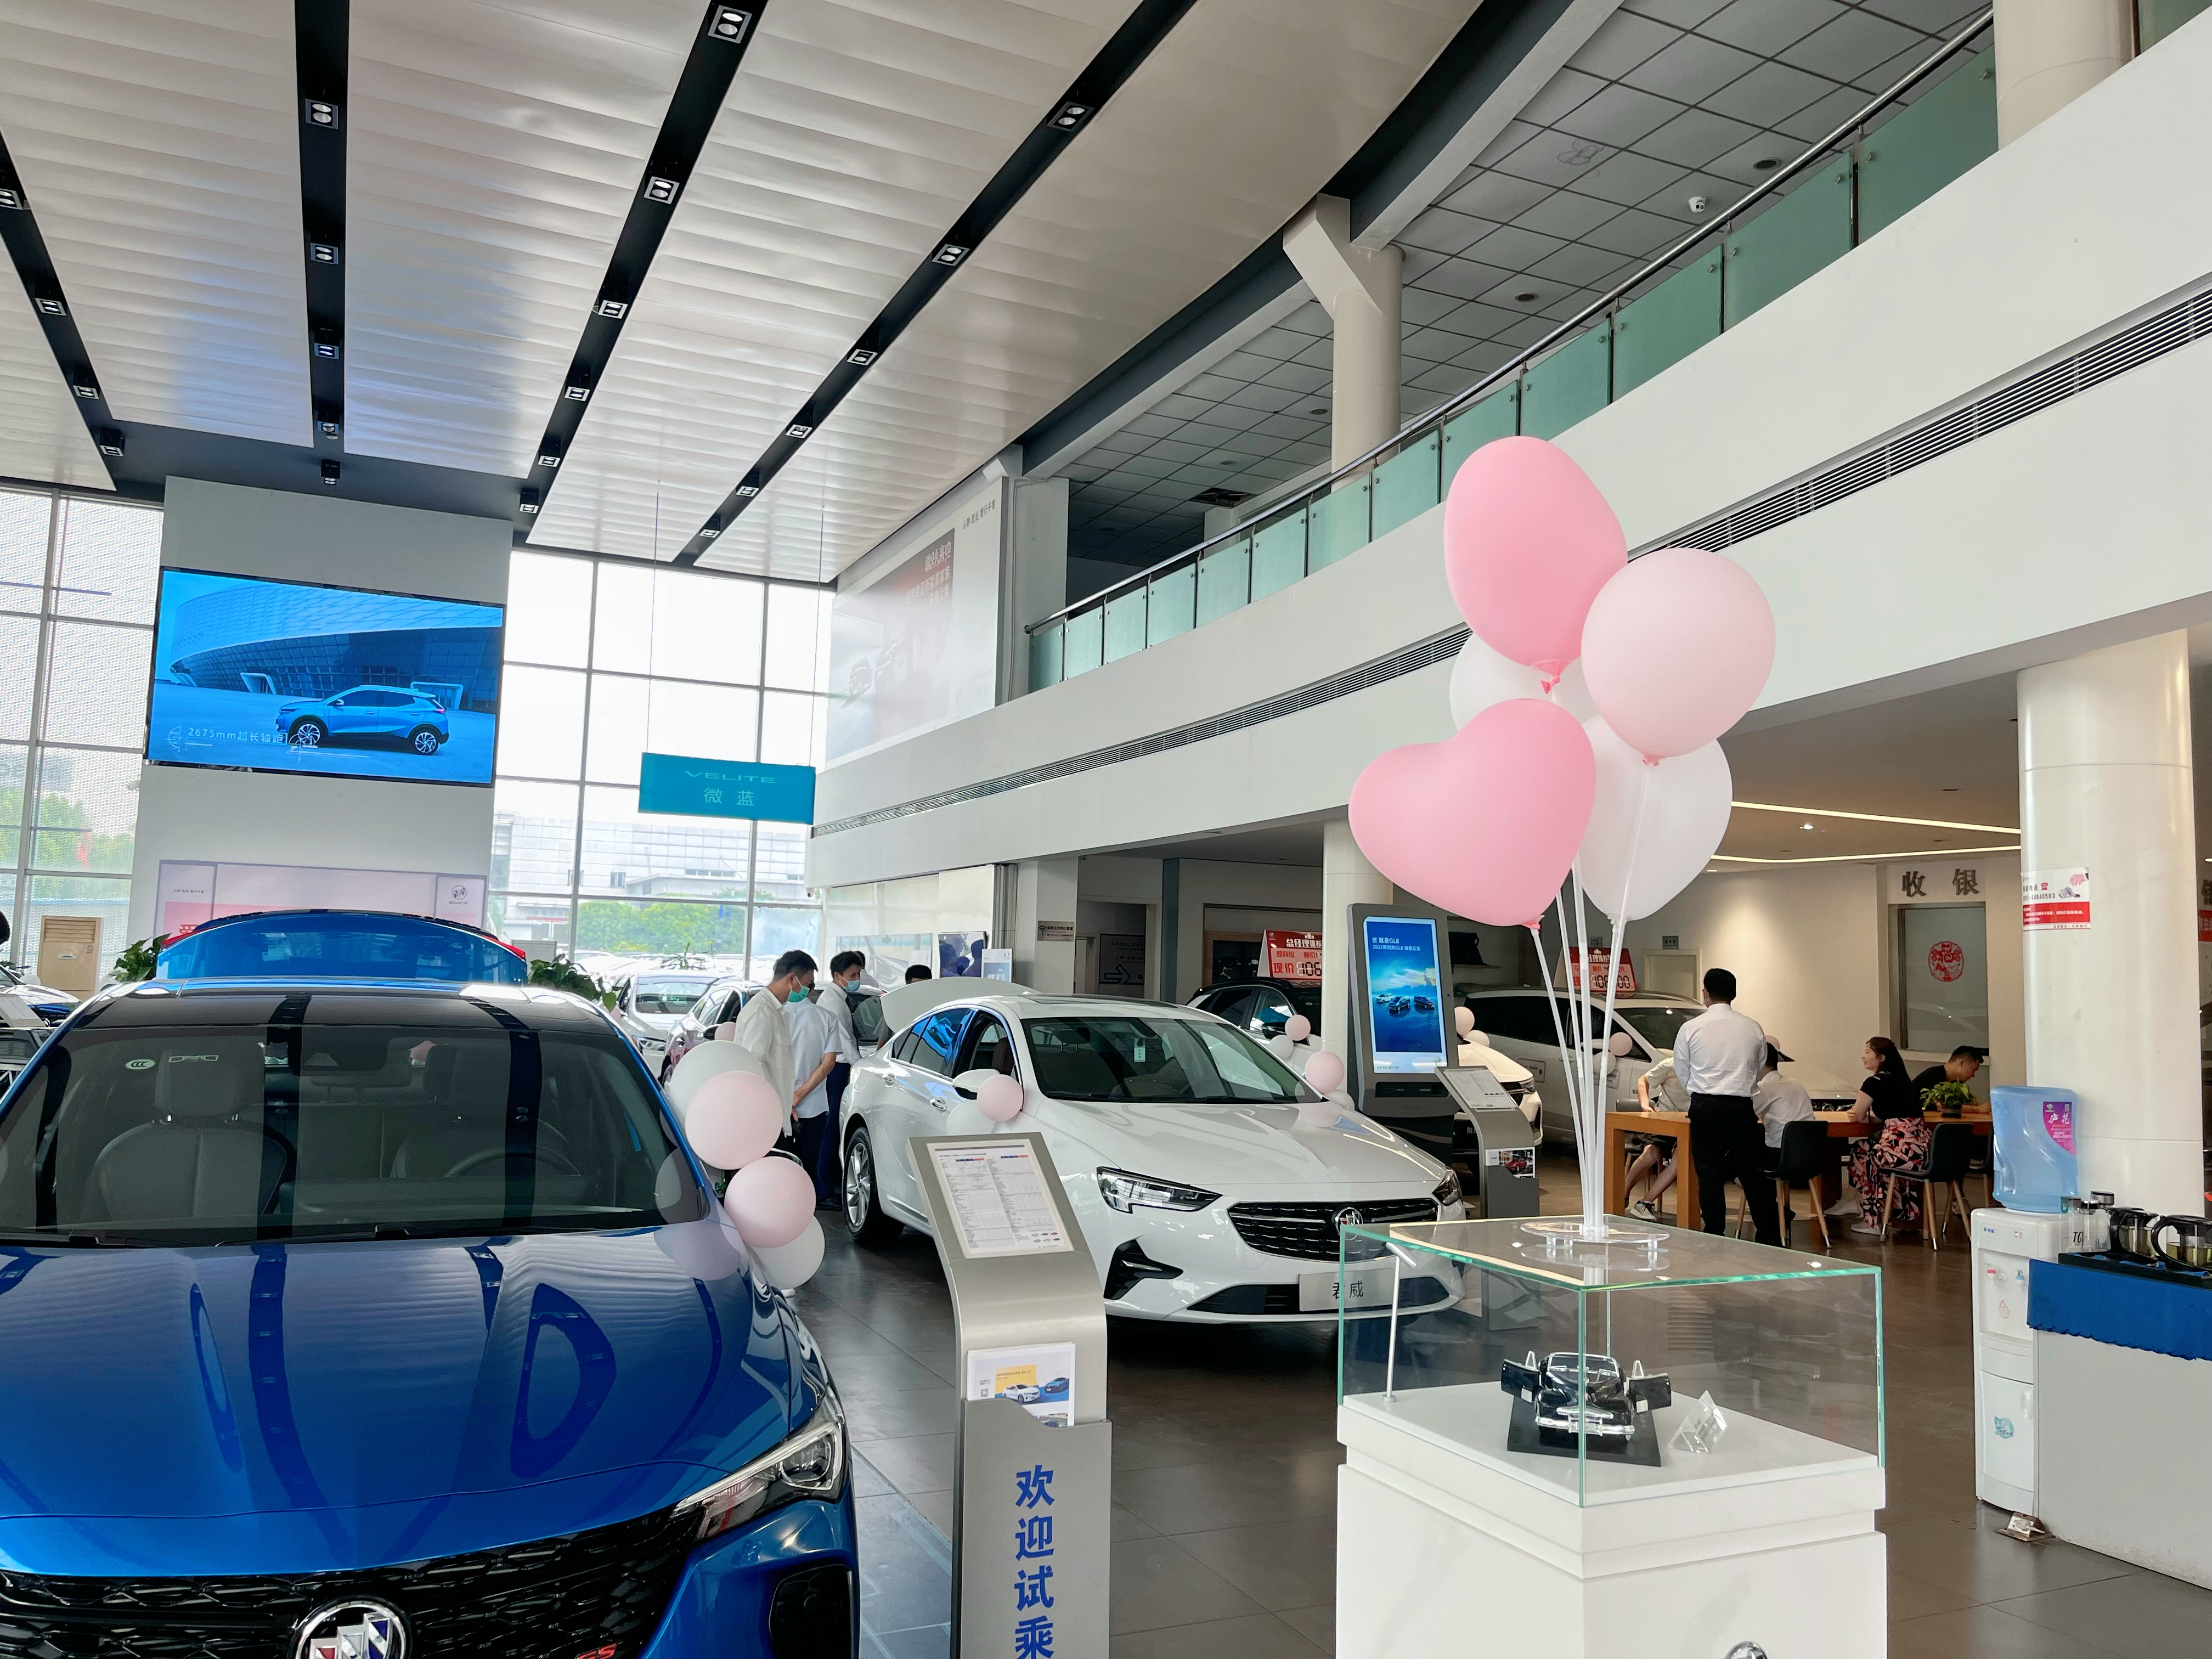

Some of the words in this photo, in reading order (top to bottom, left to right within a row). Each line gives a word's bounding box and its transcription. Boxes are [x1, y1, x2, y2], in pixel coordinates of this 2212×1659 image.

[685, 770, 776, 784] VELITE
[703, 788, 755, 806] 微蓝
[1901, 868, 1980, 898] 收银
[1273, 963, 1294, 974] 现价
[1332, 1280, 1364, 1299] 君威
[1014, 1464, 1054, 1659] 欢迎试乘
